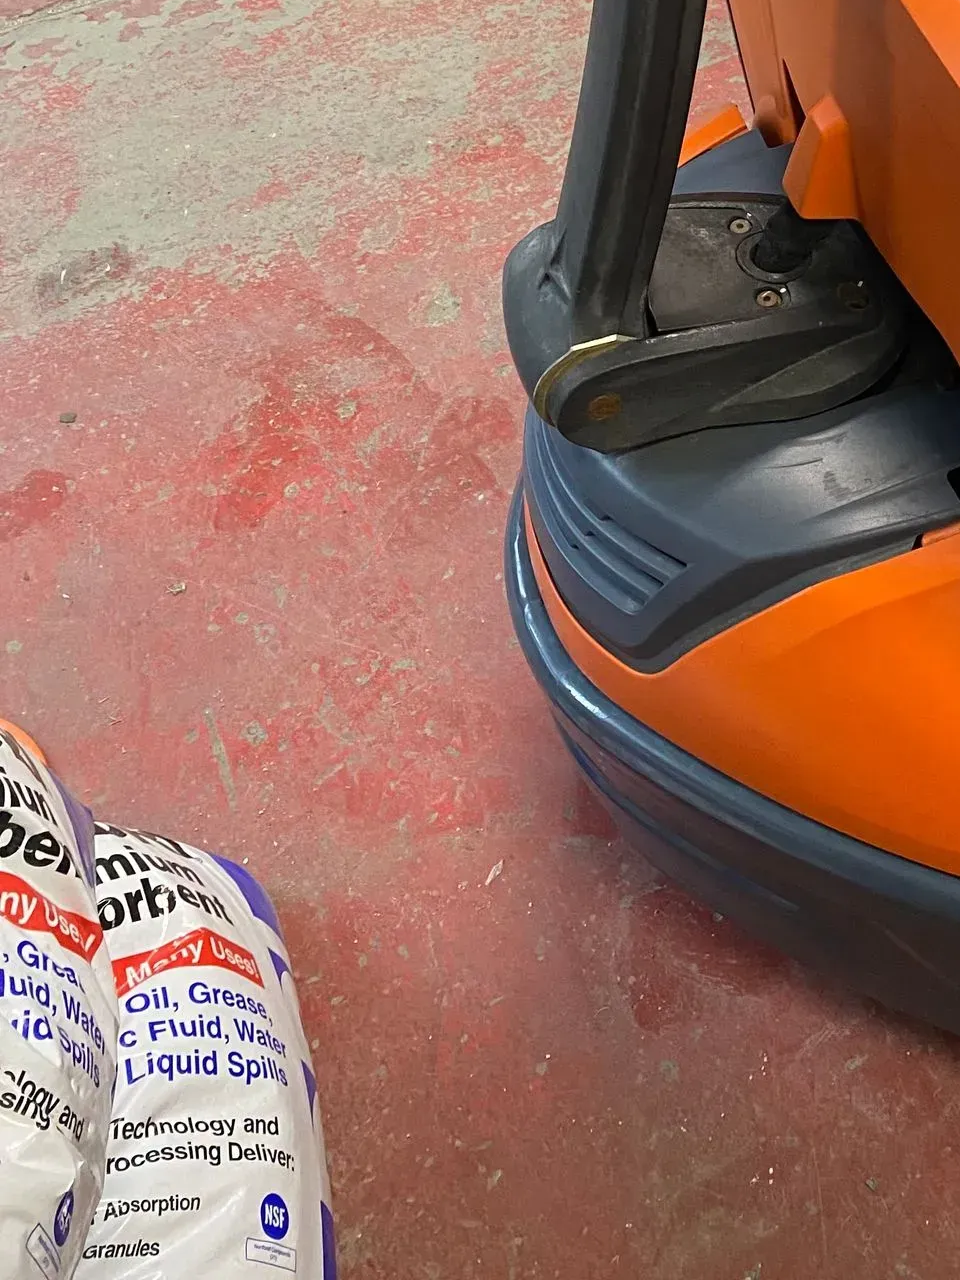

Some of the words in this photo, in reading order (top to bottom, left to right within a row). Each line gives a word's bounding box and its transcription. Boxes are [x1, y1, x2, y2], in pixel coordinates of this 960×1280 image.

[0, 810, 84, 878] ben
[94, 845, 206, 888] mium
[0, 891, 37, 925] ny
[96, 877, 234, 931] orbent
[17, 940, 85, 995] Grea
[209, 936, 260, 979] Uses!
[0, 969, 57, 1017] luid,
[125, 986, 179, 1014] Oil,
[188, 982, 273, 1027] Grease,
[57, 1025, 100, 1089] Spills
[148, 1014, 230, 1045] Fluid,
[233, 1018, 287, 1059] Water
[125, 1049, 218, 1086] Liquid
[227, 1051, 288, 1087] Spills
[59, 1105, 85, 1141] and
[109, 1116, 236, 1141] Technology
[243, 1116, 280, 1136] and
[106, 1142, 221, 1175] rocessing
[228, 1141, 296, 1172] Deliver:
[103, 1193, 201, 1222] Absorption
[264, 1202, 286, 1229] NSF
[82, 1238, 161, 1261] Granules
